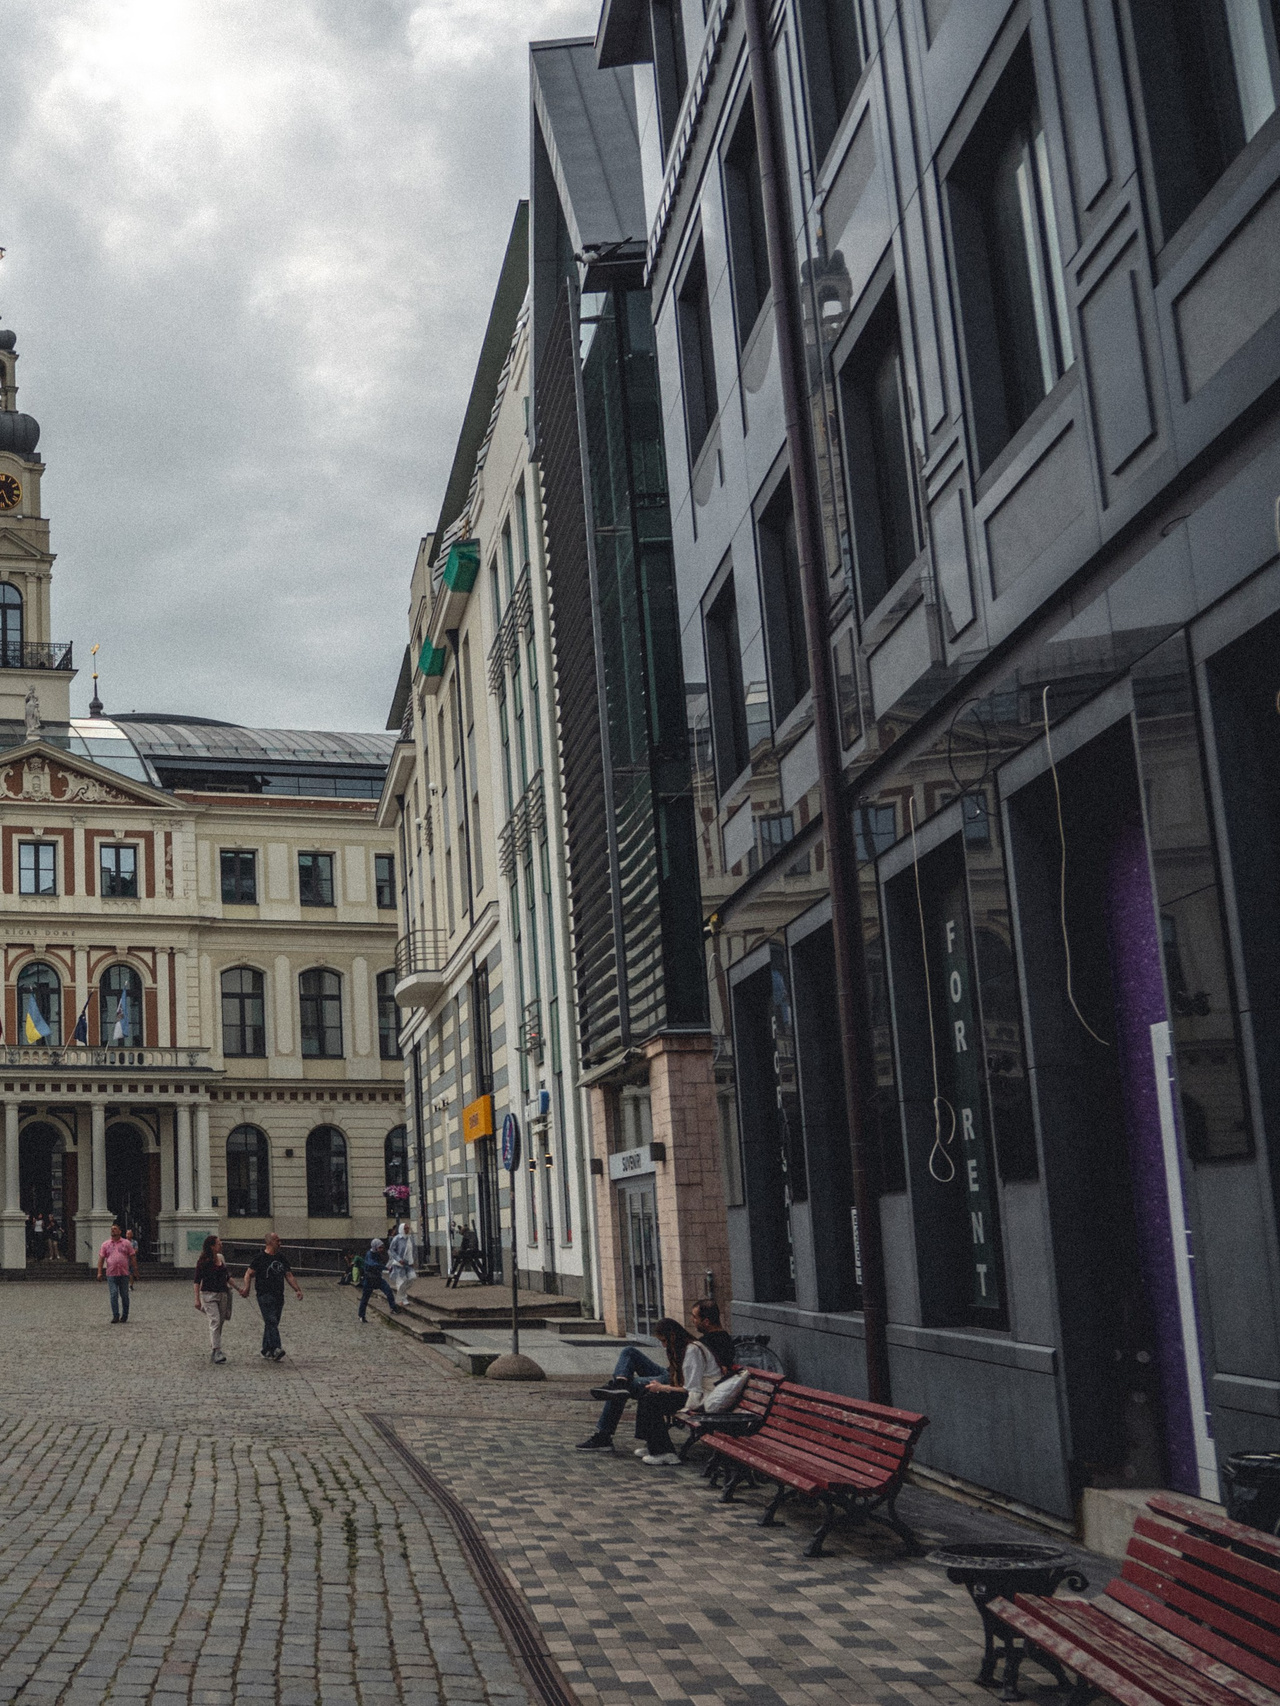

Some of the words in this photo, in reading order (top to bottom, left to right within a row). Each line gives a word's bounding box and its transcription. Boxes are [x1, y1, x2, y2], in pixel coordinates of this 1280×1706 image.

[45, 929, 76, 937] DOME
[770, 1015, 782, 1109] FOR
[945, 920, 968, 1053] FOR
[961, 1107, 988, 1297] RENT
